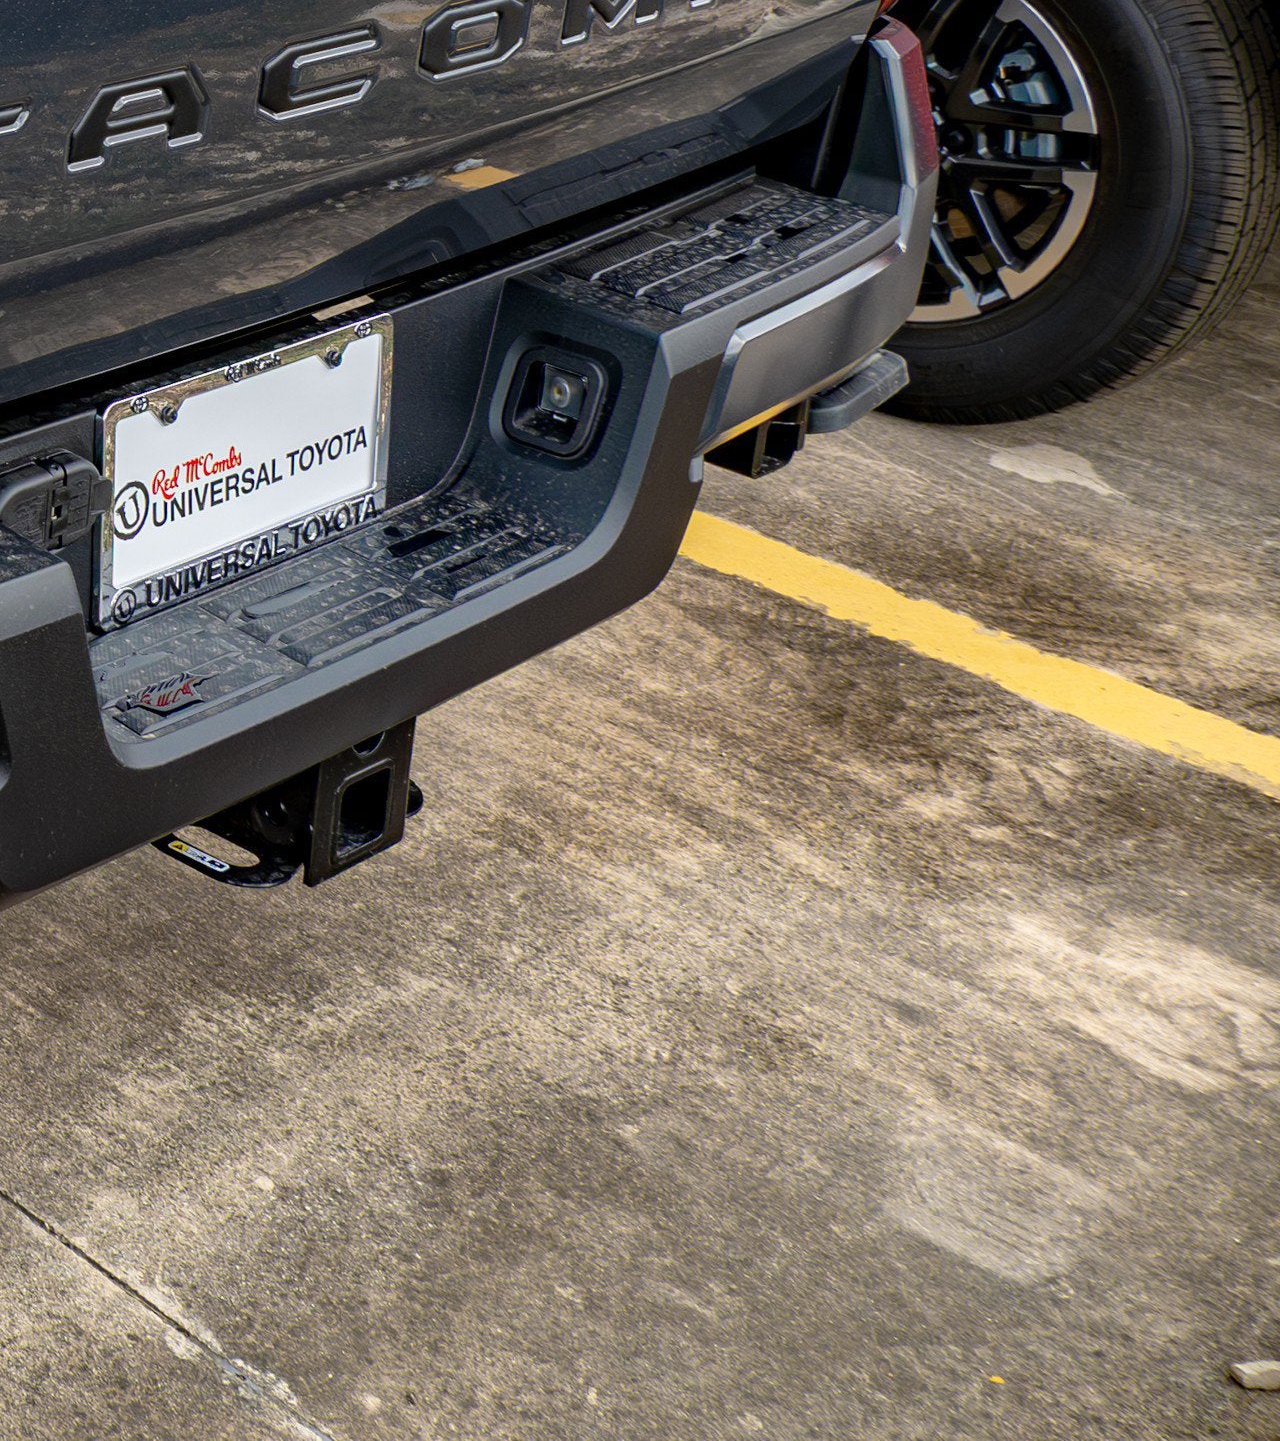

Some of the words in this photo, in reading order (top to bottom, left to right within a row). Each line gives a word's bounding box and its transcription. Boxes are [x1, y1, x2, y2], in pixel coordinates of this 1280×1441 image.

[151, 469, 180, 500] Red
[183, 446, 242, 484] McCombs
[152, 458, 283, 528] UNIVERSAL
[286, 425, 368, 477] TOYOTA
[144, 531, 287, 608] UNIVERSAL
[290, 495, 378, 550] TOYOTA
